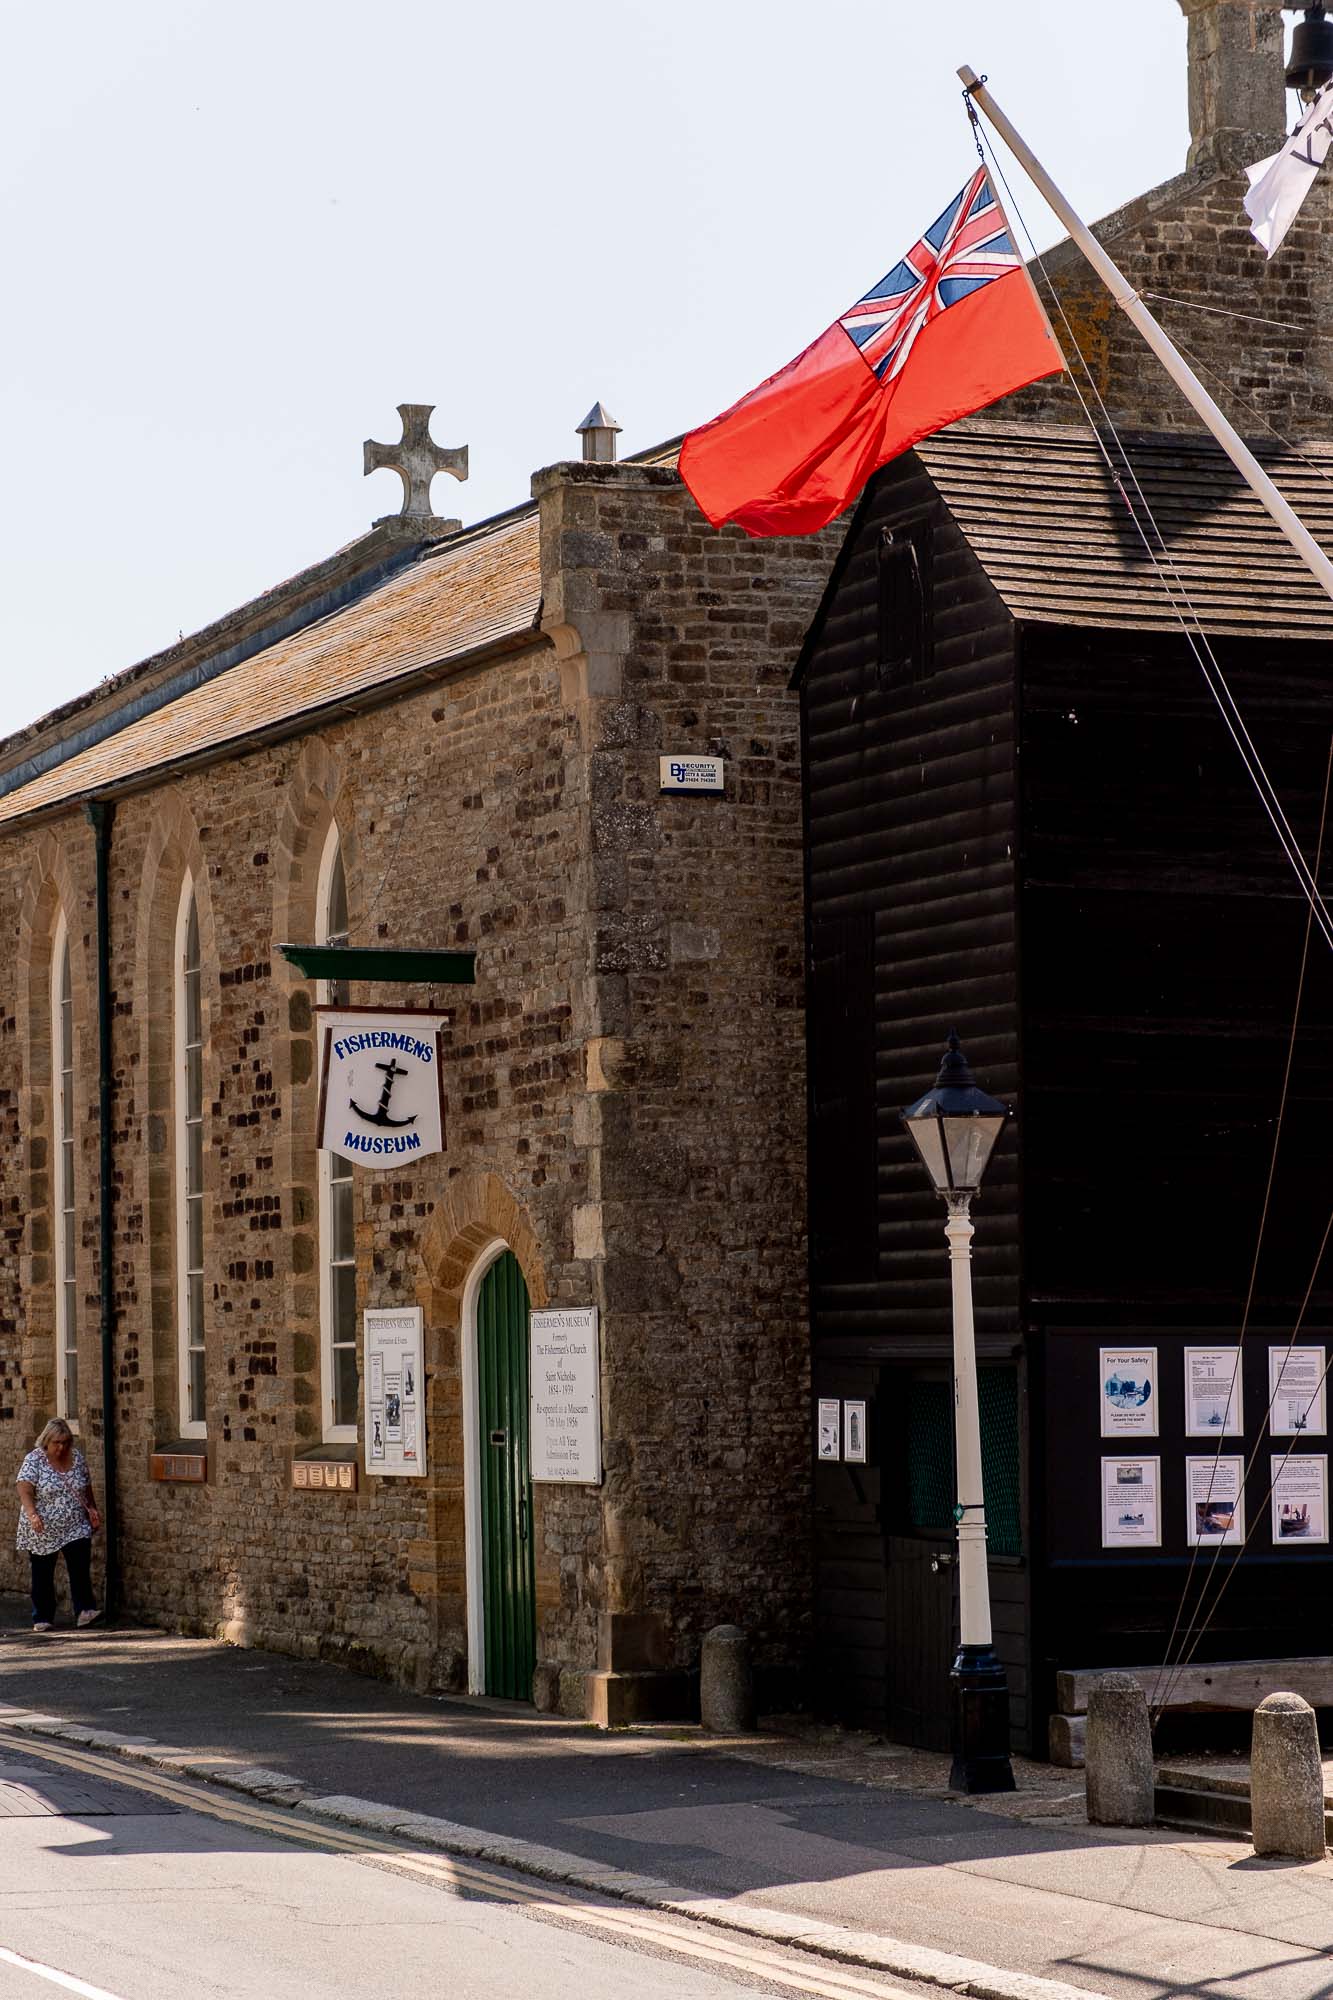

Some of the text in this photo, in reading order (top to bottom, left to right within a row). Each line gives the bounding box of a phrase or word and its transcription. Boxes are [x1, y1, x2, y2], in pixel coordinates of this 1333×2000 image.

[344, 1132, 421, 1154] MUSEUM
[566, 1316, 590, 1328] MUSEUM
[536, 1345, 544, 1355] The
[569, 1343, 587, 1354] Church
[1131, 1357, 1149, 1365] Safety
[545, 1370, 577, 1381] Saint Nicholas
[567, 1403, 588, 1414] Museum
